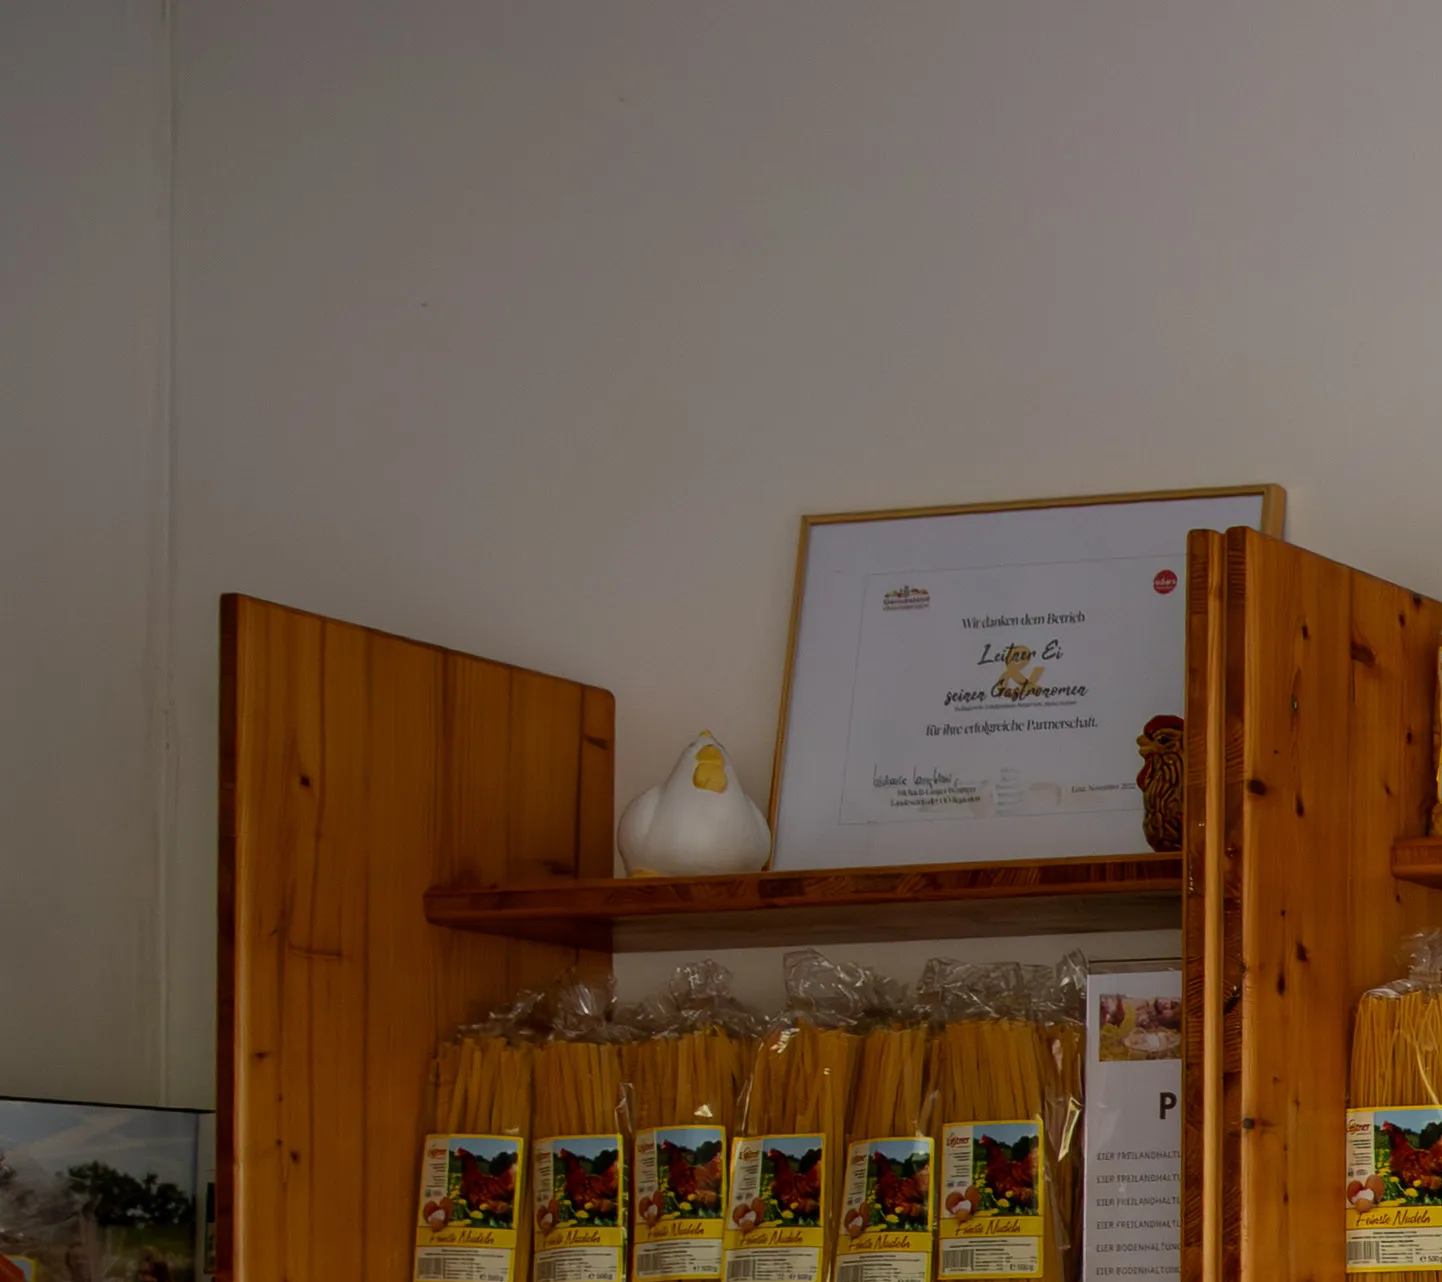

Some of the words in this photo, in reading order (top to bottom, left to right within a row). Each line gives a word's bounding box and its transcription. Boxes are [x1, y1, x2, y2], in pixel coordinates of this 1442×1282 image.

[981, 614, 1019, 629] danken
[1020, 613, 1045, 626] dem
[1041, 638, 1064, 661] Ei
